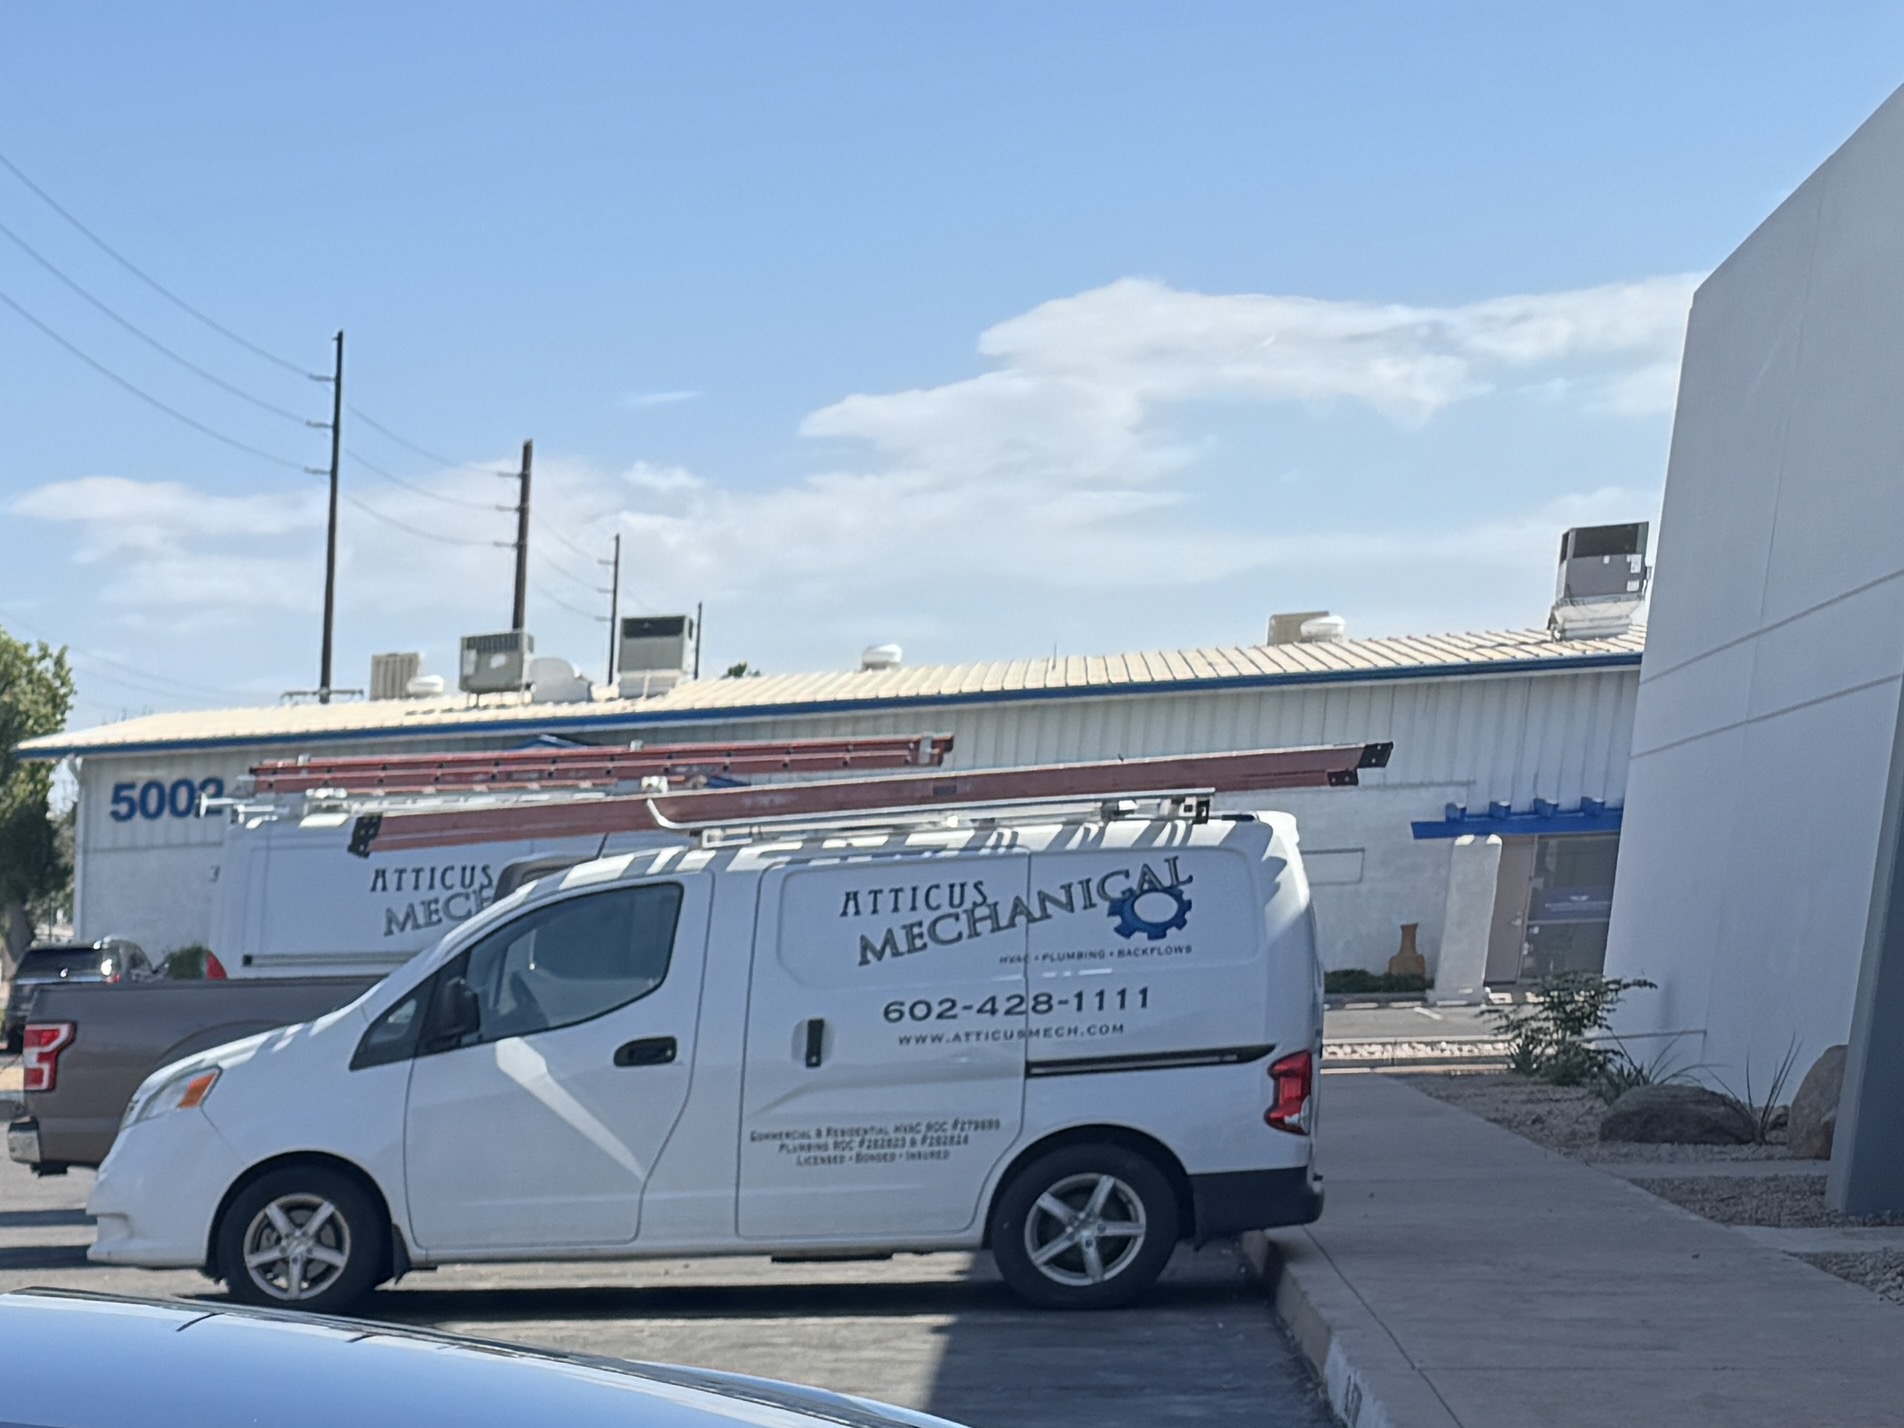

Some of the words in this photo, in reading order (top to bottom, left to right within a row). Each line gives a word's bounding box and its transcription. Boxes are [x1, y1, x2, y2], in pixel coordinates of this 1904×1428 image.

[109, 776, 224, 822] 5002
[370, 864, 493, 892] ATTICUS
[839, 880, 988, 917] ATTICUS
[858, 855, 1194, 967] MECHANICAL
[1042, 949, 1106, 963] PLUMBING
[1117, 944, 1192, 958] BACKFLOWS
[883, 986, 1149, 1023] 602-428-1111
